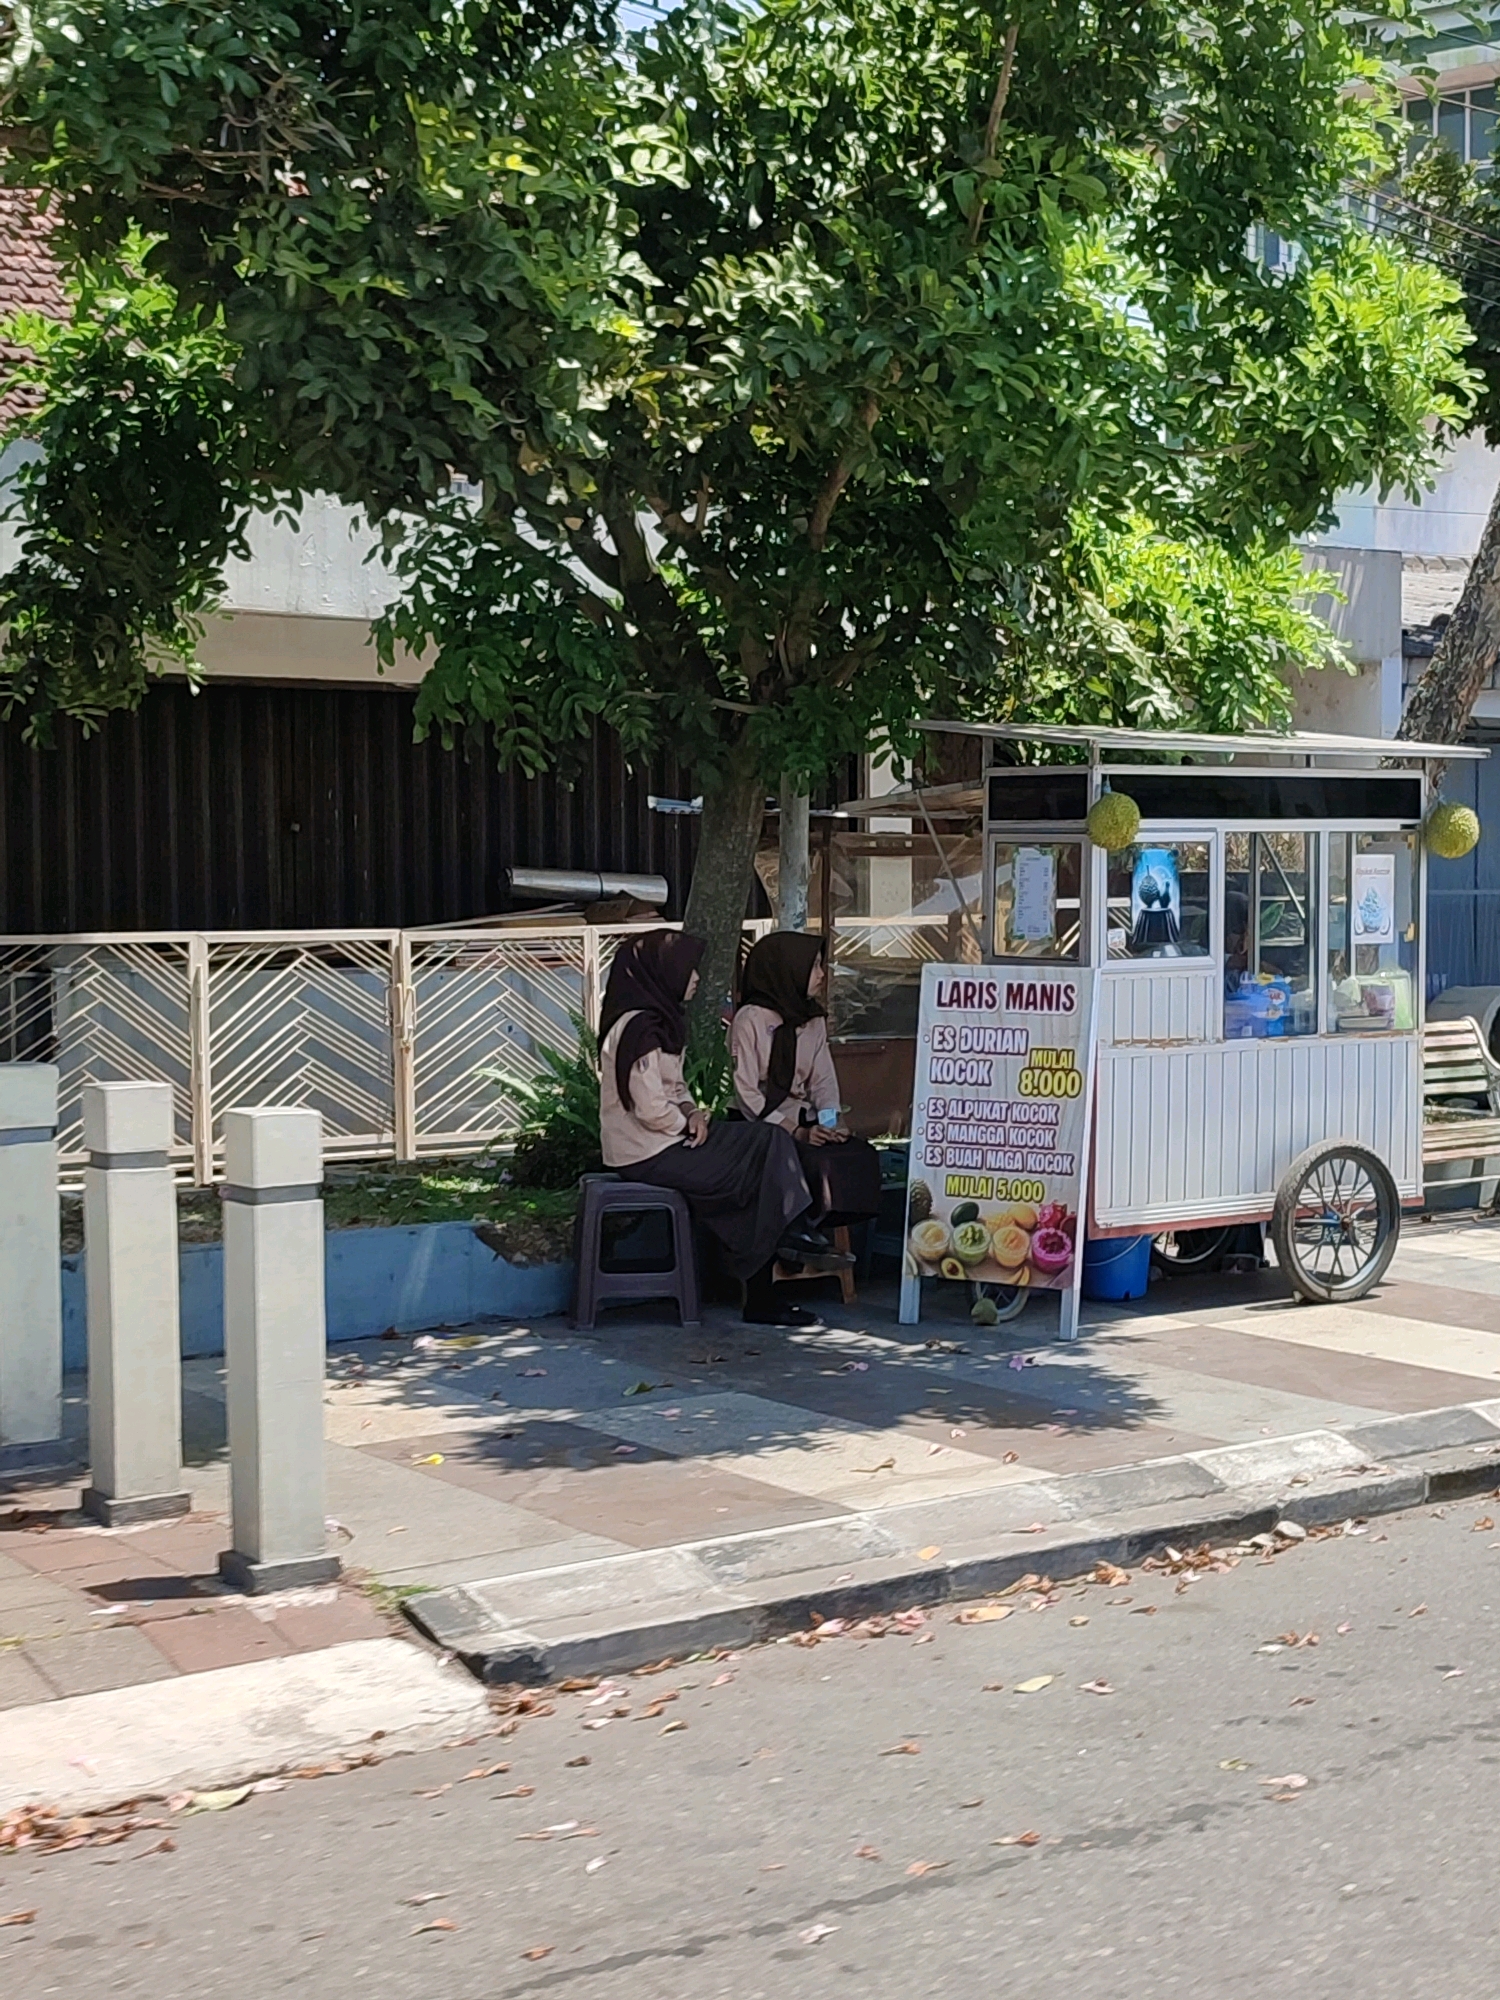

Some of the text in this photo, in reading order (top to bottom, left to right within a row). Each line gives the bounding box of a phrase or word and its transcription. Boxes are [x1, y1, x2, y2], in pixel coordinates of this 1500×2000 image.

[936, 980, 1076, 1012] LARIS MANIS
[931, 1025, 1029, 1055] ES DURIAN
[929, 1057, 992, 1086] KOCOK
[1029, 1048, 1075, 1069] MULAI
[1018, 1067, 1082, 1098] 8.000
[927, 1097, 1059, 1126] ES ALPUKAT KOCOK
[926, 1122, 1056, 1150] ES MANGGA KOCOK
[924, 1146, 1074, 1176] ES BUAH NAGA KOCOK
[945, 1174, 1045, 1203] MULAI 5.000
